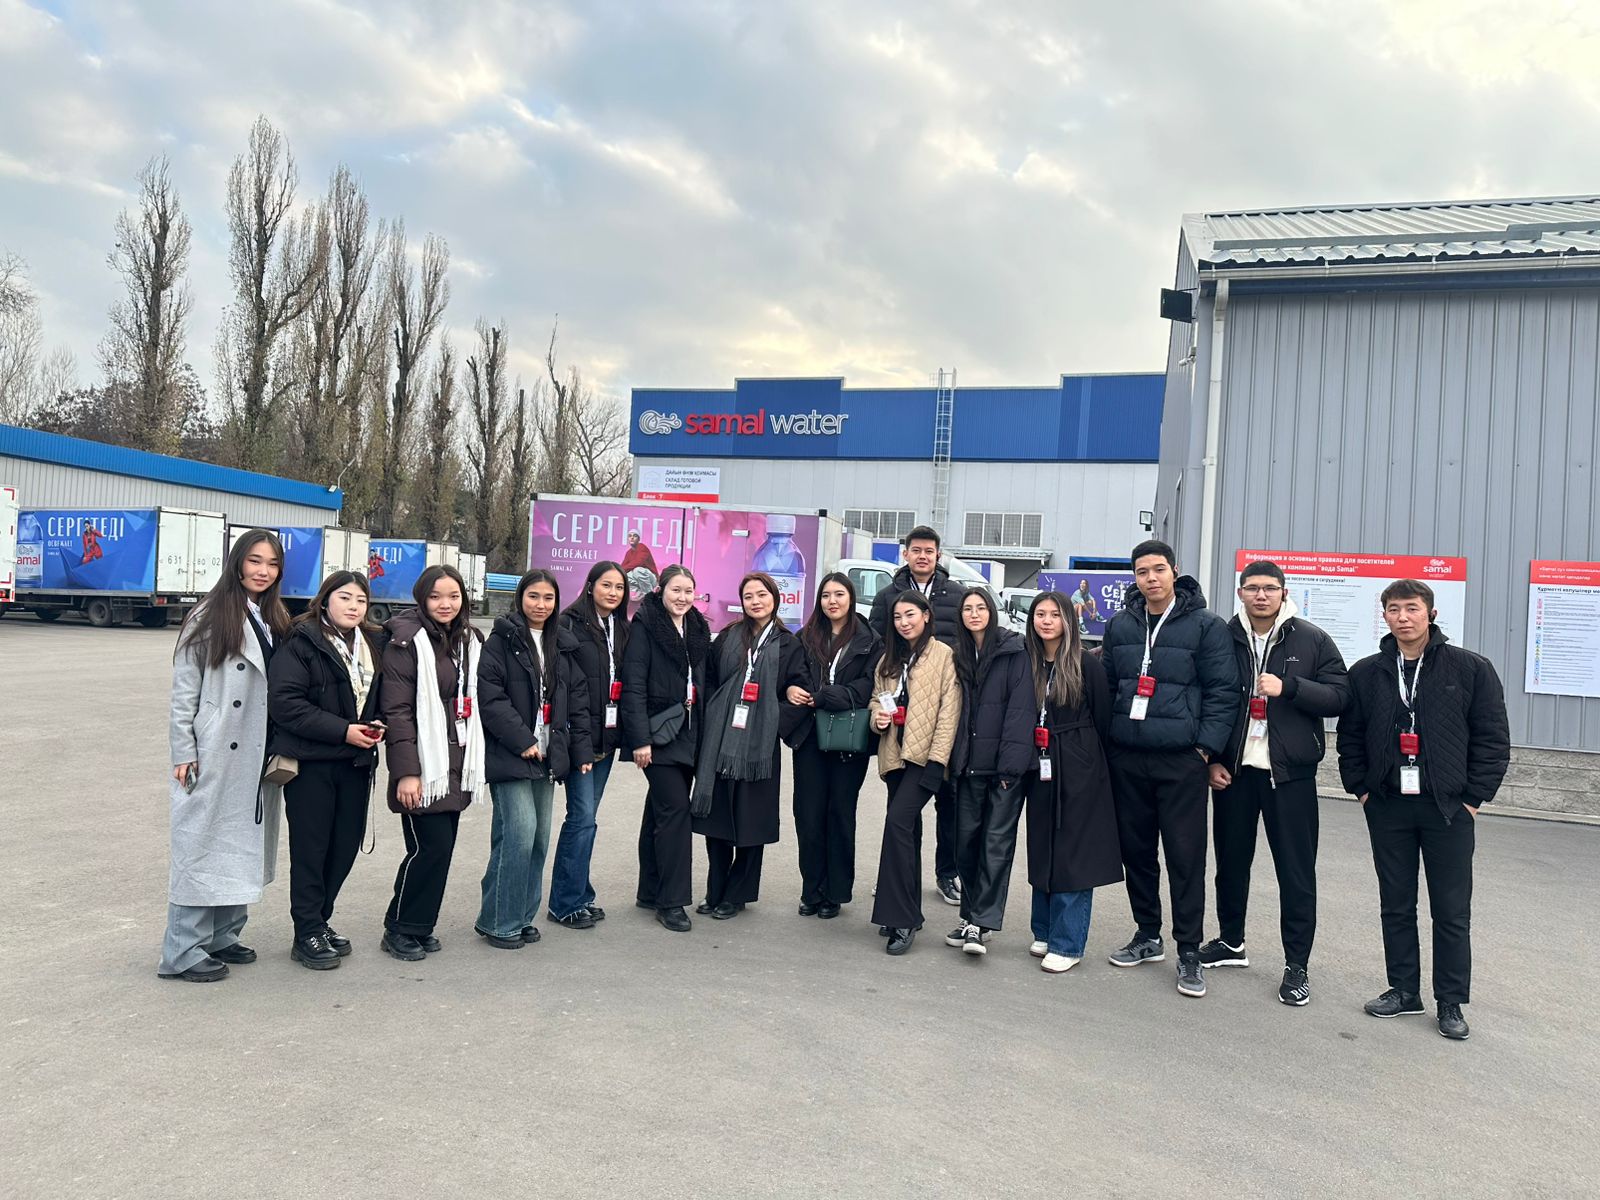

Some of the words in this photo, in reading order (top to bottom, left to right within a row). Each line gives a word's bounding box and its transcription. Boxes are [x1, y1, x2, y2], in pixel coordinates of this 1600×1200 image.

[685, 408, 765, 435] samal
[769, 409, 848, 435] water
[48, 516, 125, 542] СЕРГТЕДІ
[552, 512, 694, 555] СЕРГІТЕДІ
[16, 554, 41, 565] amal
[551, 547, 598, 560] ОСВЕЖАЕТ
[1245, 553, 1283, 562] Информация
[1423, 565, 1452, 573] samal
